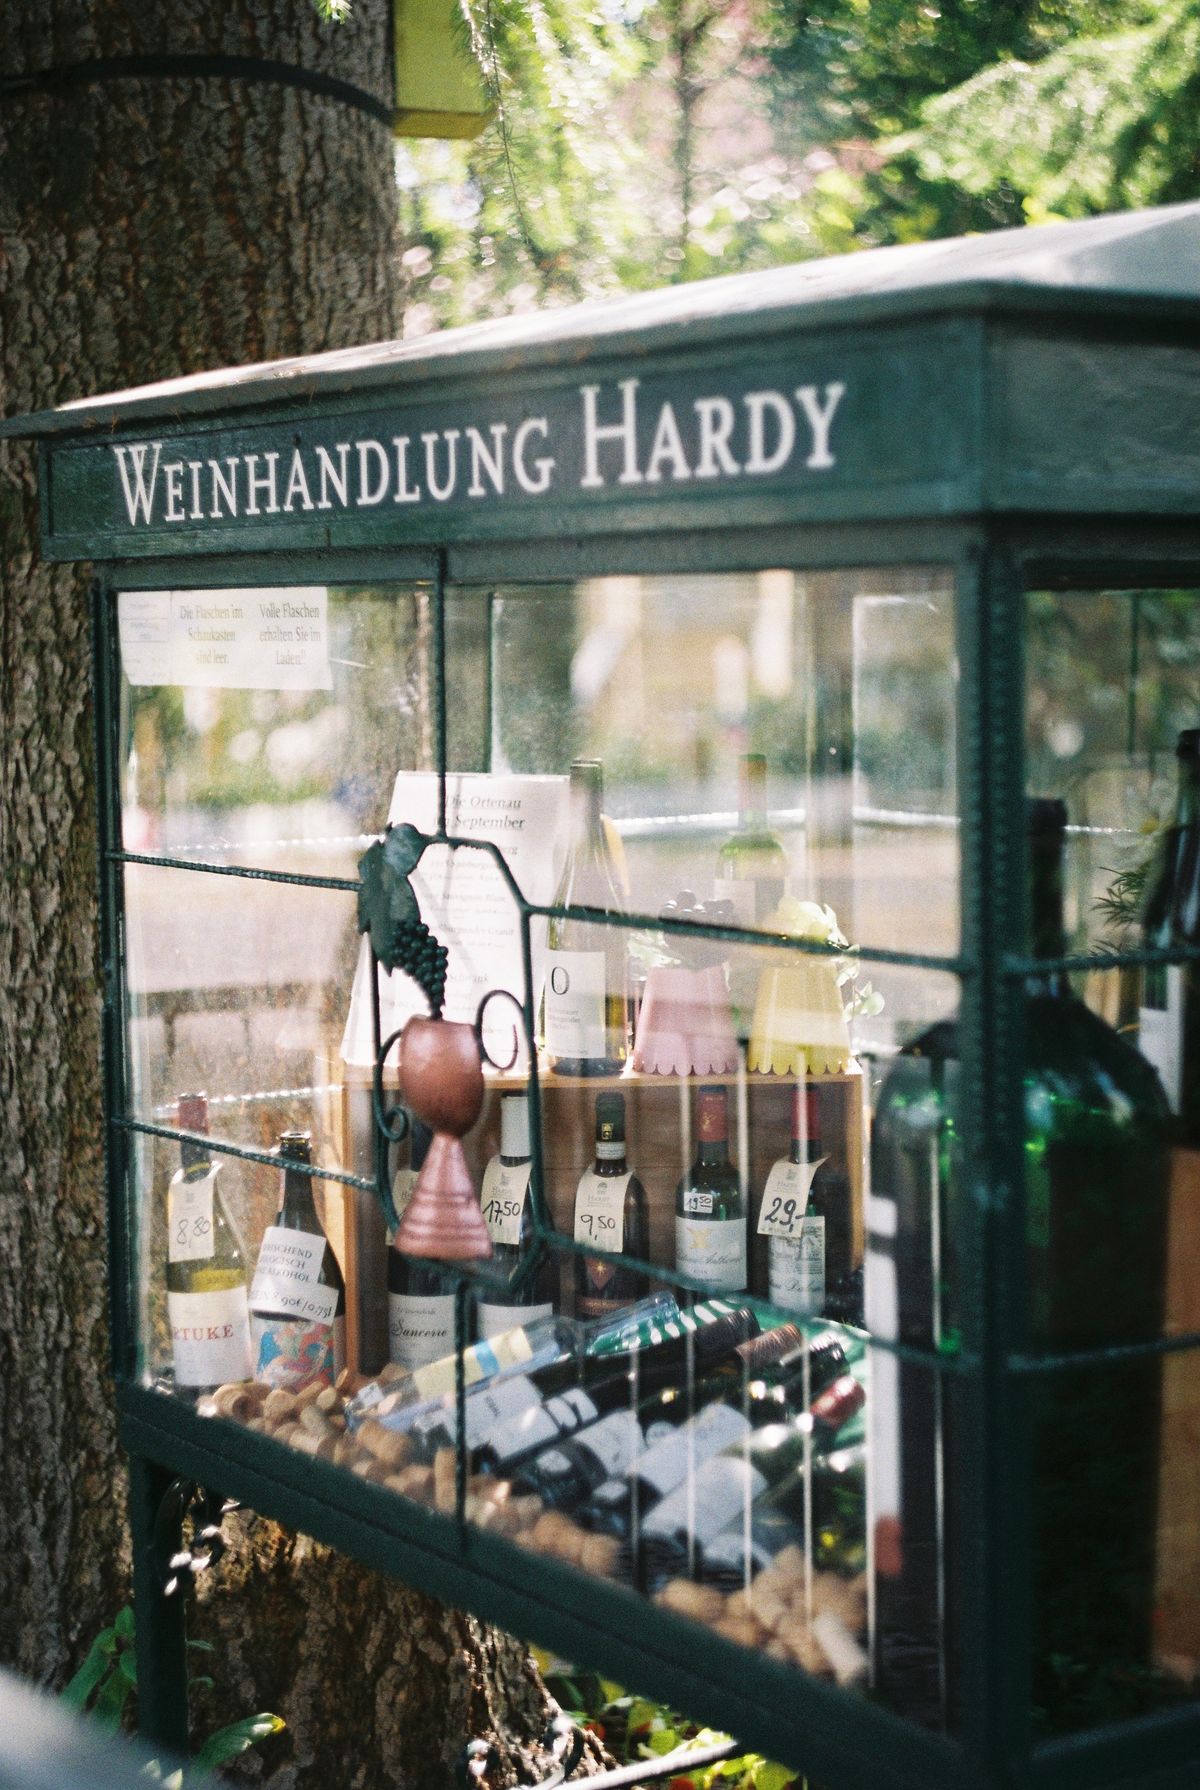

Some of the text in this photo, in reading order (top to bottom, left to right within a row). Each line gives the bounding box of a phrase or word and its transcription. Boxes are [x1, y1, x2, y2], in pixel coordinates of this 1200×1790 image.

[112, 379, 844, 527] WEINHANDLUNG HARDY
[179, 605, 193, 620] Die
[259, 602, 321, 618] Volle Flaschen
[258, 626, 293, 641] erhalten
[295, 626, 309, 641] Sie
[454, 814, 526, 831] September
[580, 1214, 616, 1240] 9,50
